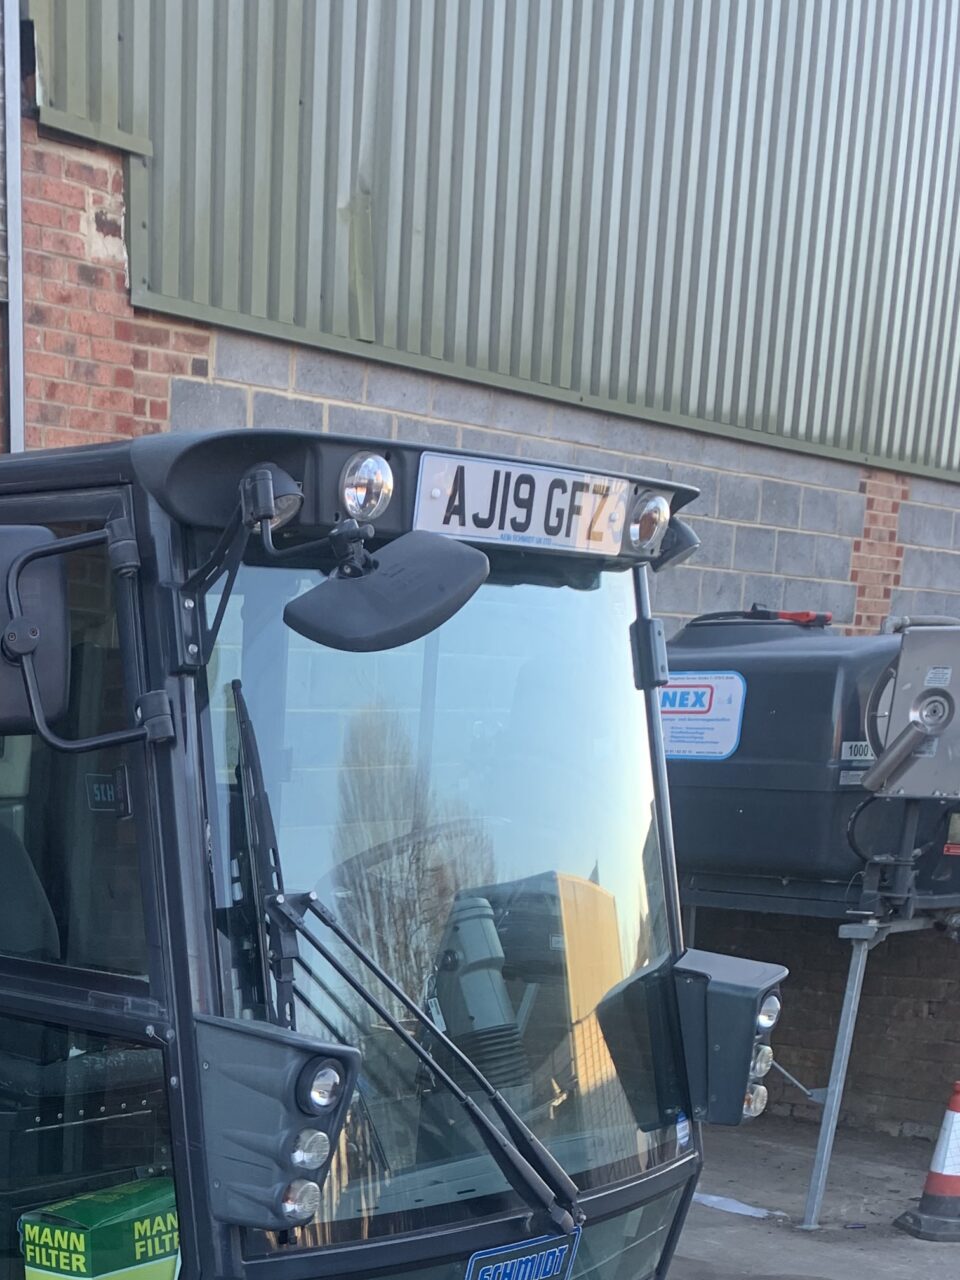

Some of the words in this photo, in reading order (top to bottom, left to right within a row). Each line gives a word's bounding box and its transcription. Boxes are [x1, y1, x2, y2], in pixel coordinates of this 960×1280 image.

[544, 478, 610, 541] GFZ
[849, 744, 869, 757] 1000
[24, 1223, 86, 1252] MANN
[25, 1243, 87, 1273] FILTER
